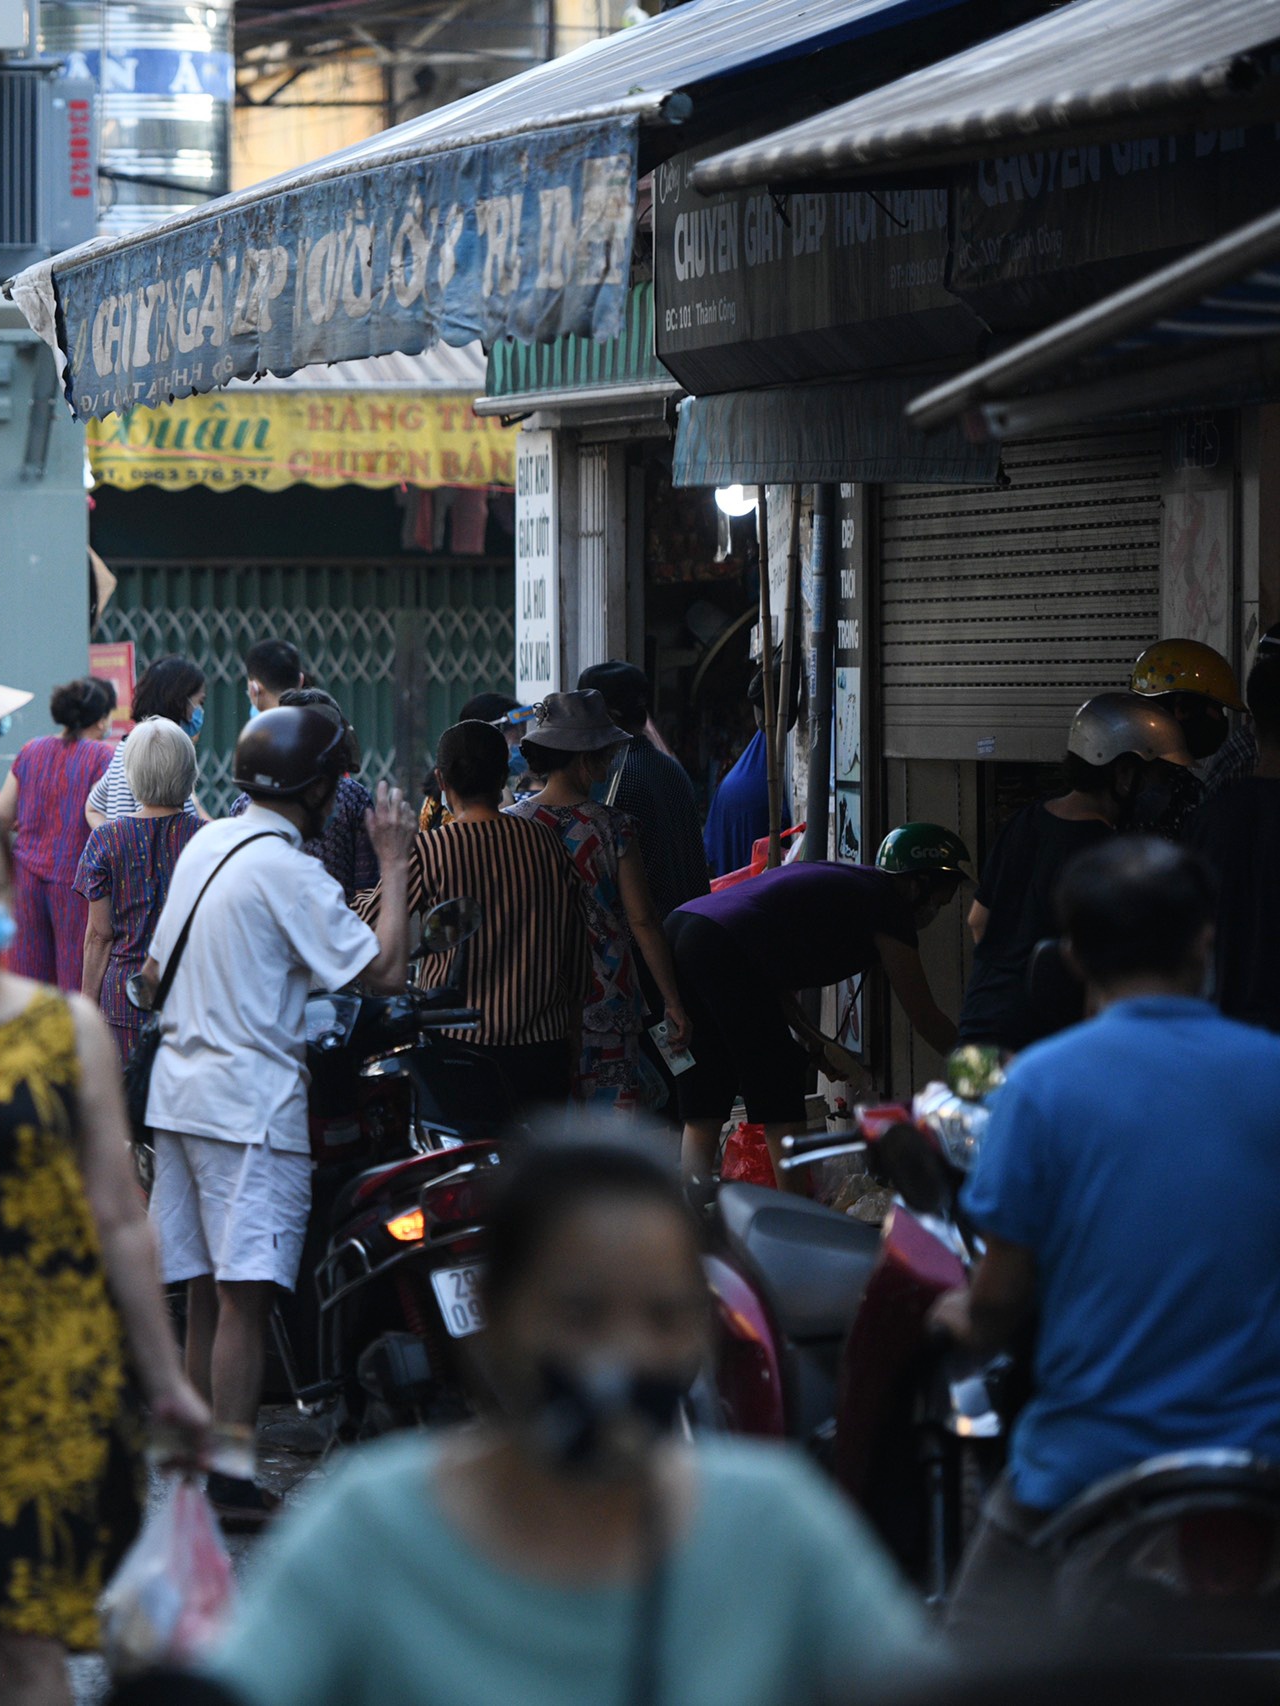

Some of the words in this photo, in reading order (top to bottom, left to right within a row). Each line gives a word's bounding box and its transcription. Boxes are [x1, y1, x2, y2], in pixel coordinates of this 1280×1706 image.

[673, 191, 739, 283] CHUYÊN
[665, 308, 678, 332] ĐC:
[679, 304, 692, 329] 101
[695, 299, 718, 326] Thành
[718, 295, 736, 325] Công
[290, 441, 431, 481] CHUYÊN
[438, 441, 512, 481] BÁN
[535, 443, 550, 496] KHÔ
[841, 512, 855, 549] DÉP
[837, 619, 859, 649] TRANG
[535, 633, 551, 682] KHÔ
